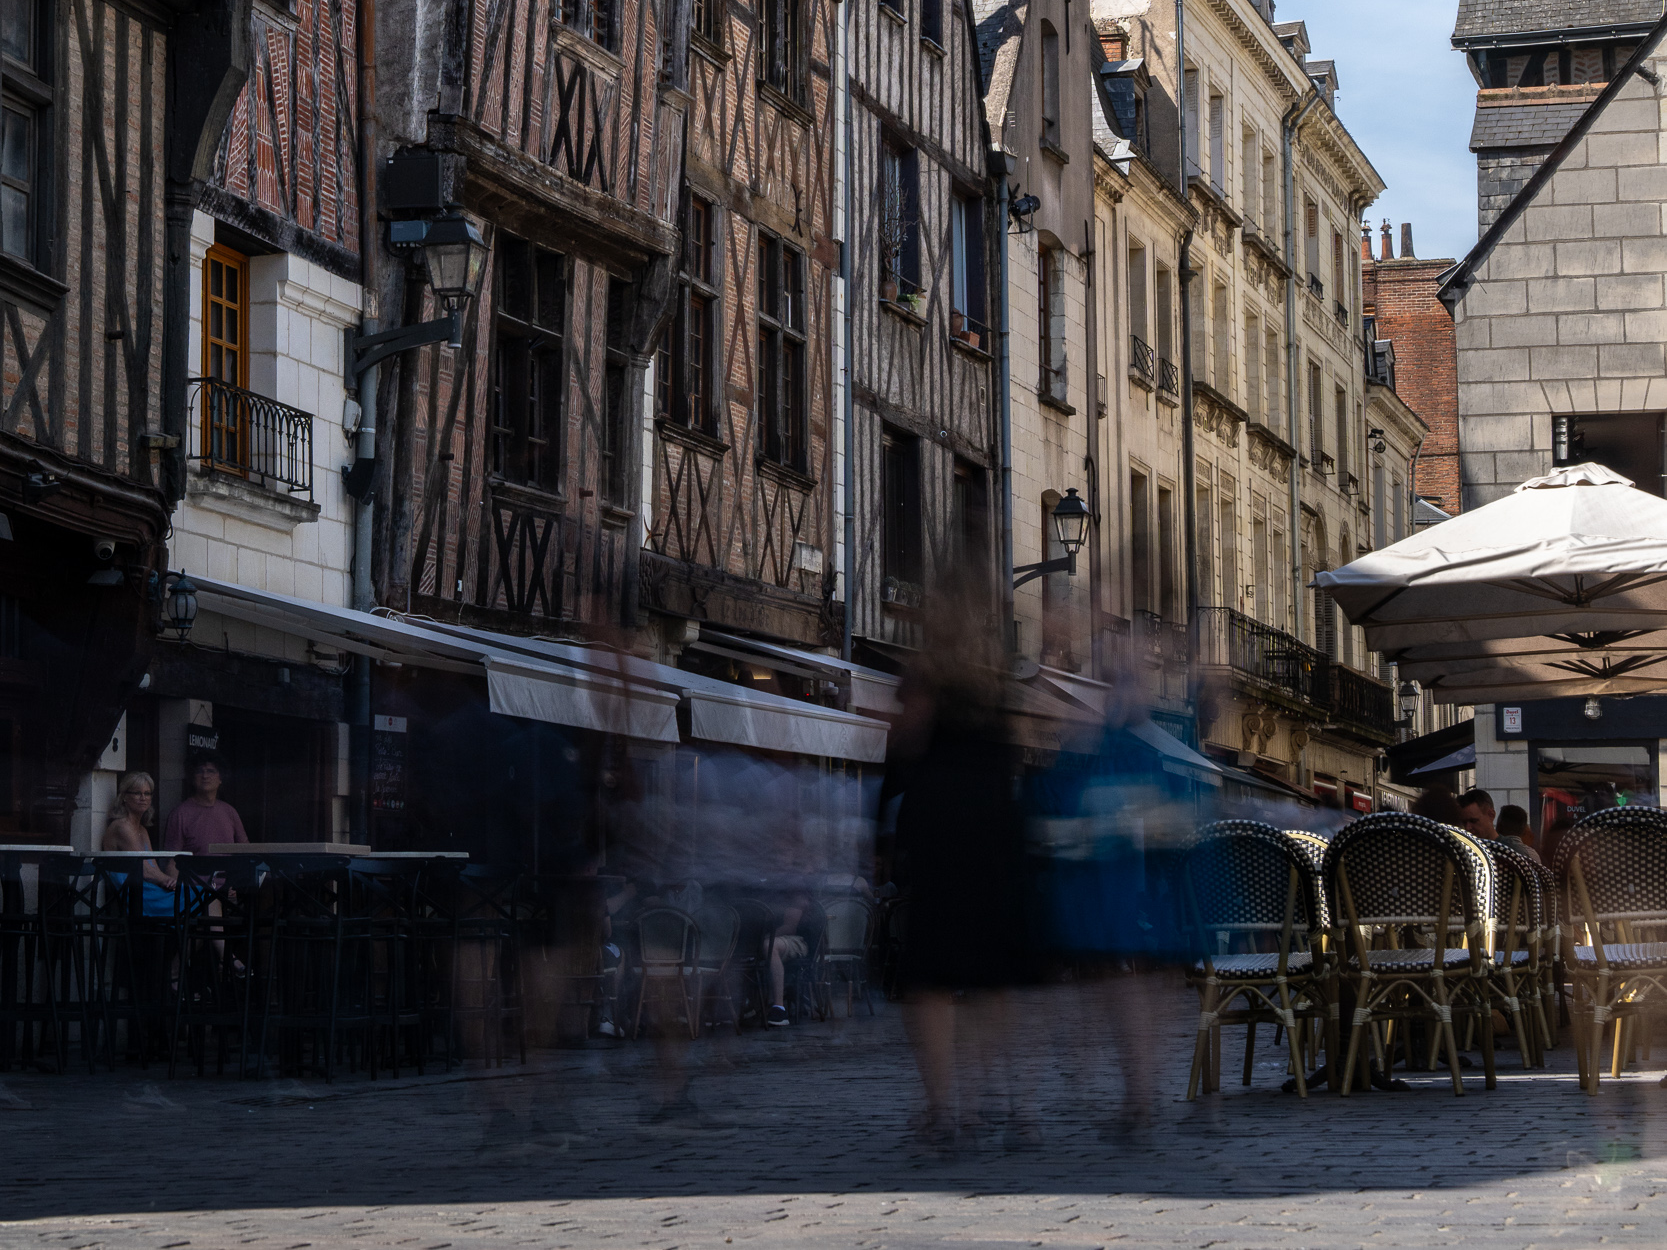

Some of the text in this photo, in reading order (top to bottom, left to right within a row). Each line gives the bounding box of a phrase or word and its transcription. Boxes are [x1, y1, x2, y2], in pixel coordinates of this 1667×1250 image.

[1509, 717, 1516, 725] 13
[112, 737, 119, 753] 8
[1566, 805, 1587, 813] DUVEL
